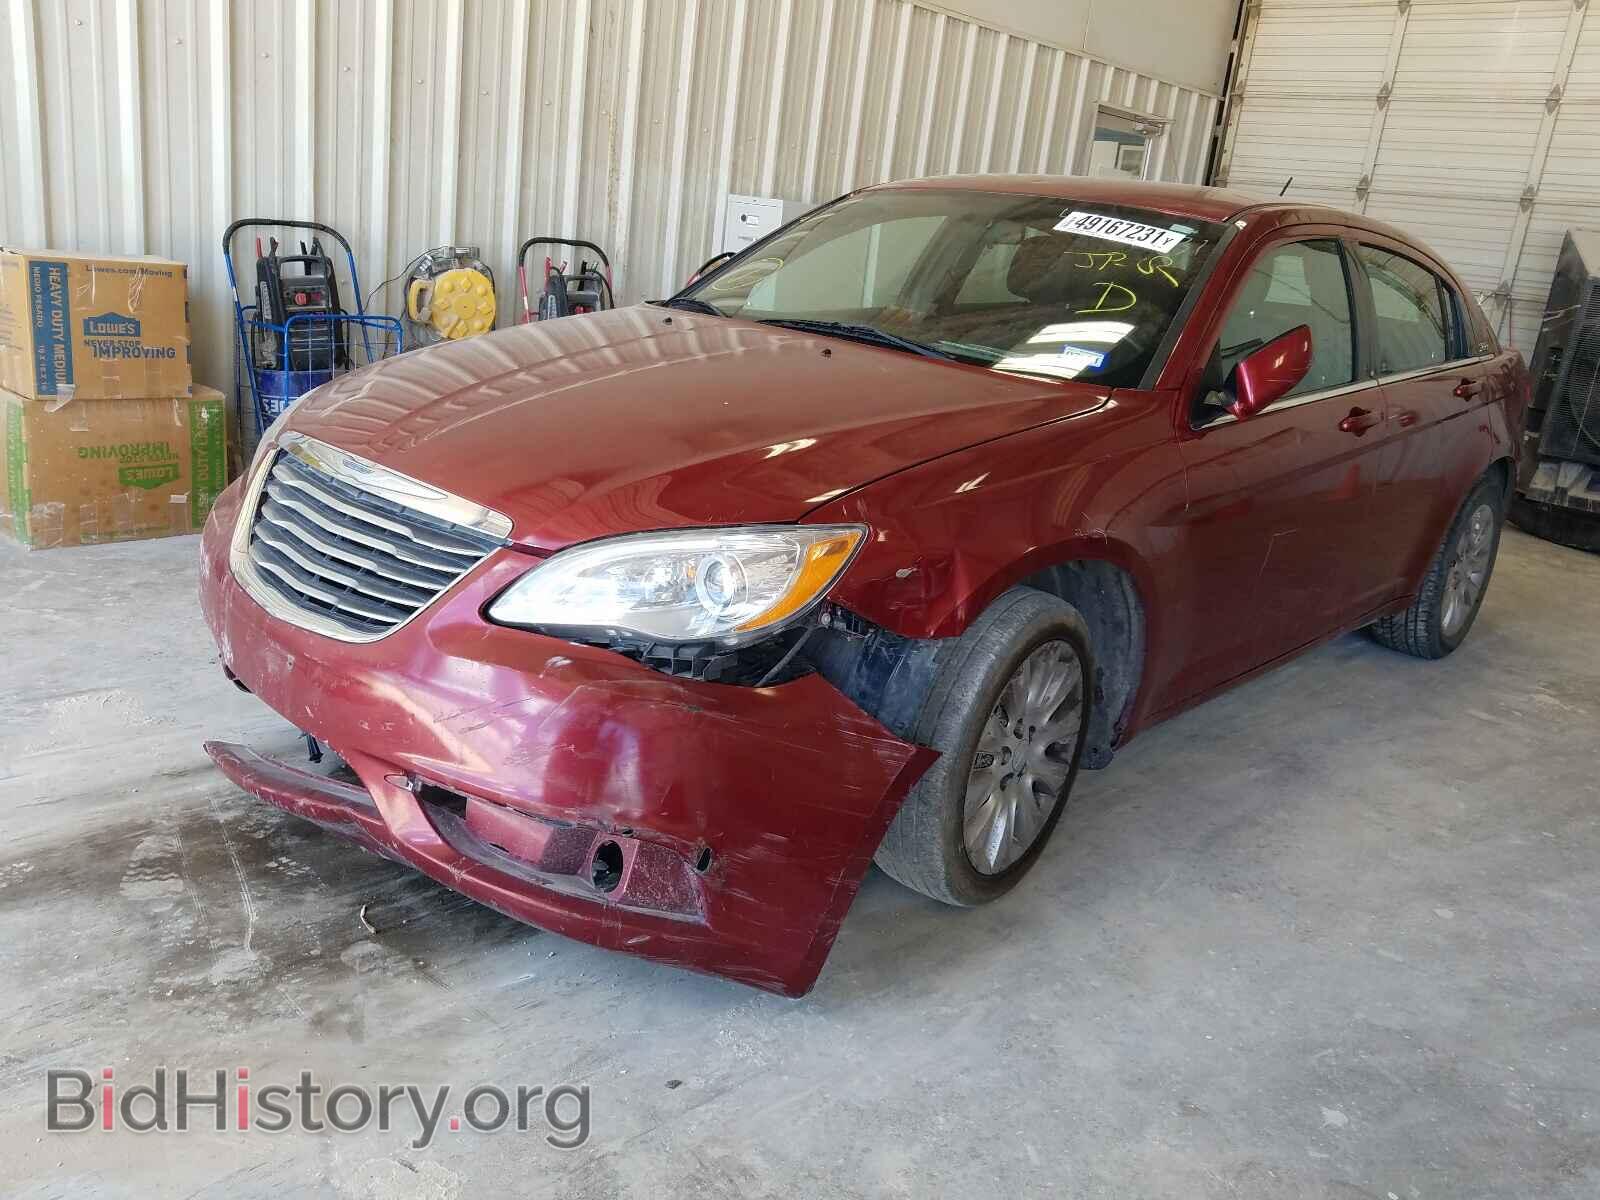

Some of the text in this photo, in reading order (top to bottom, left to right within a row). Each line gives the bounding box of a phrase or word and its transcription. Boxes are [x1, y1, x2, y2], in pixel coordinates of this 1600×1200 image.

[1075, 214, 1168, 245] 49167231
[49, 266, 62, 306] HEAVY
[51, 309, 65, 341] DUTY
[92, 344, 176, 359] IMPROVING
